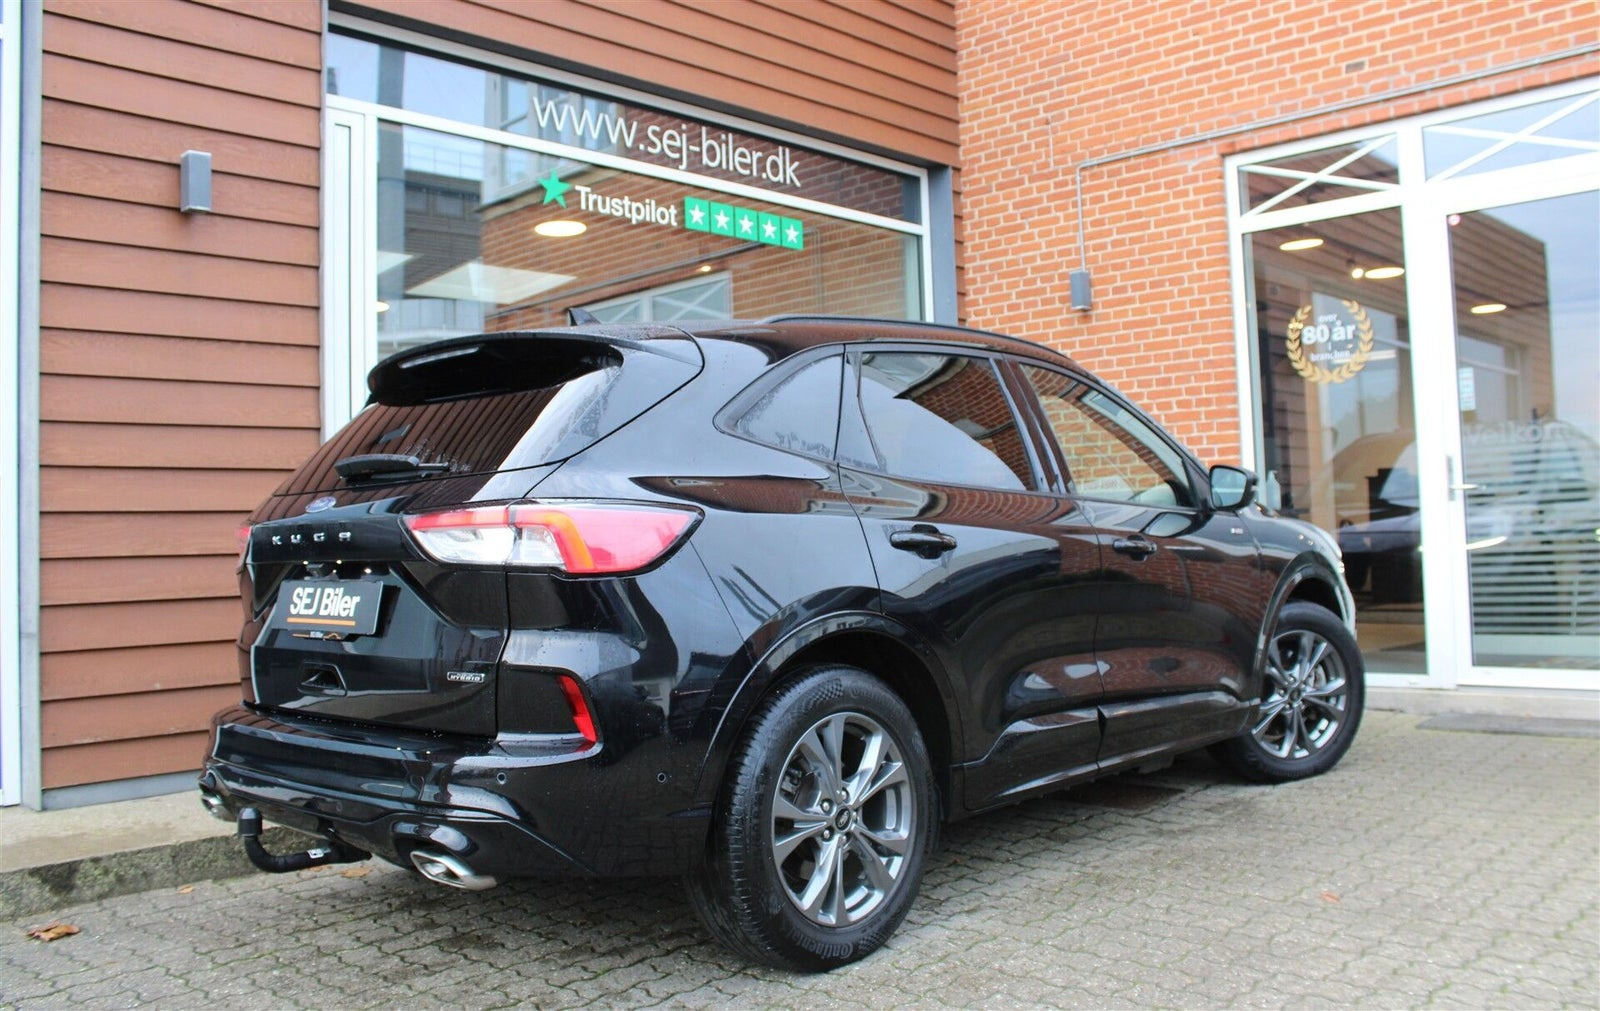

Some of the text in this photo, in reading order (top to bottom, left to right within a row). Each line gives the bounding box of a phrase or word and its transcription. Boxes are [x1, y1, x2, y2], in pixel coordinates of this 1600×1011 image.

[532, 97, 802, 188] www.sej-biler.dk
[575, 184, 678, 227] Trustpilot
[1301, 319, 1356, 345] 80 år
[271, 530, 352, 546] KUGA
[290, 587, 361, 617] SEJ Biler
[449, 673, 482, 682] HYBRID
